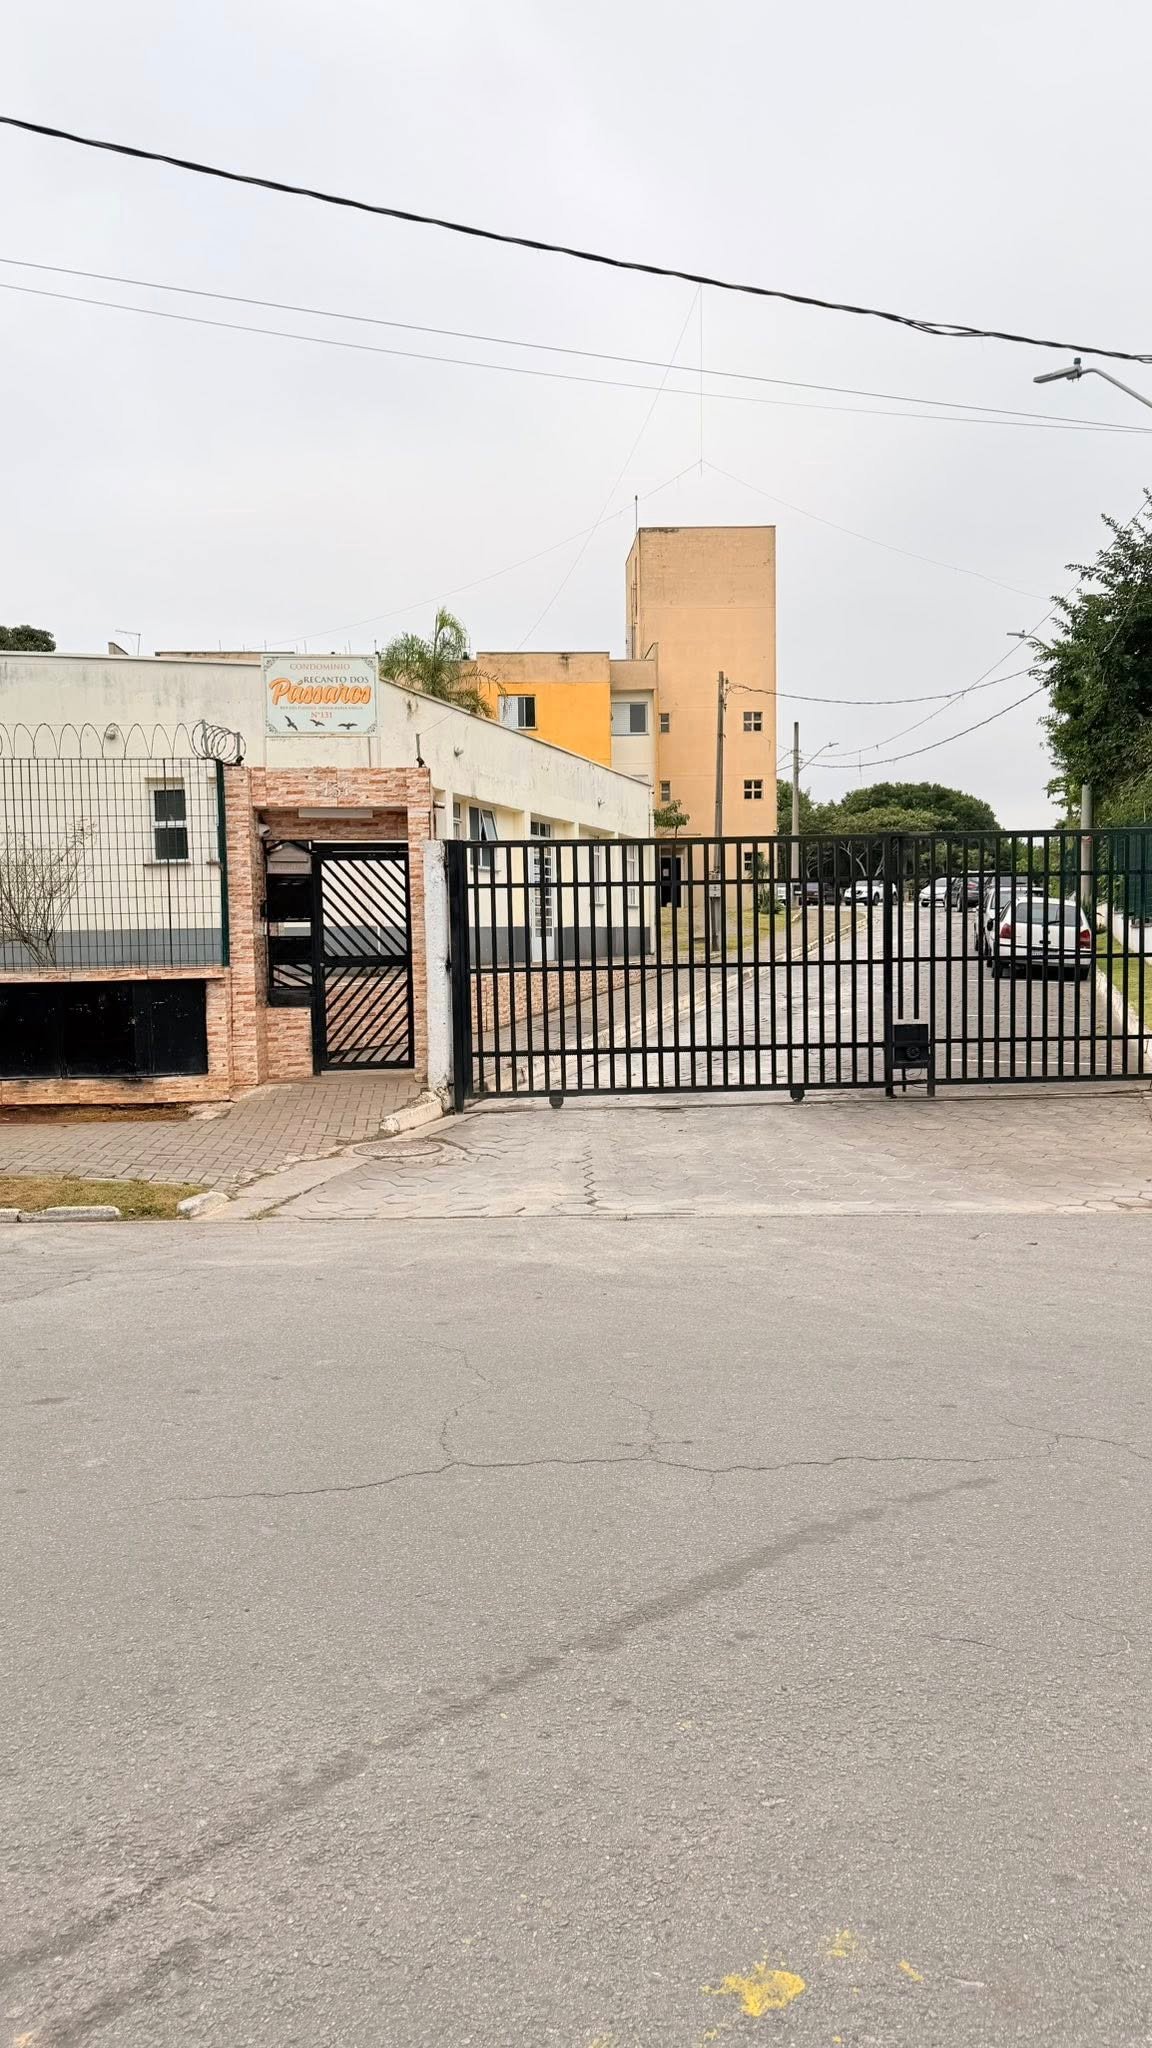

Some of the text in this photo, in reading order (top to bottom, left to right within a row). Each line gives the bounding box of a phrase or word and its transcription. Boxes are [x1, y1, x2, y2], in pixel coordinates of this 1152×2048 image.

[303, 676, 369, 684] RECANTO DOS
[269, 677, 372, 706] Pássaros
